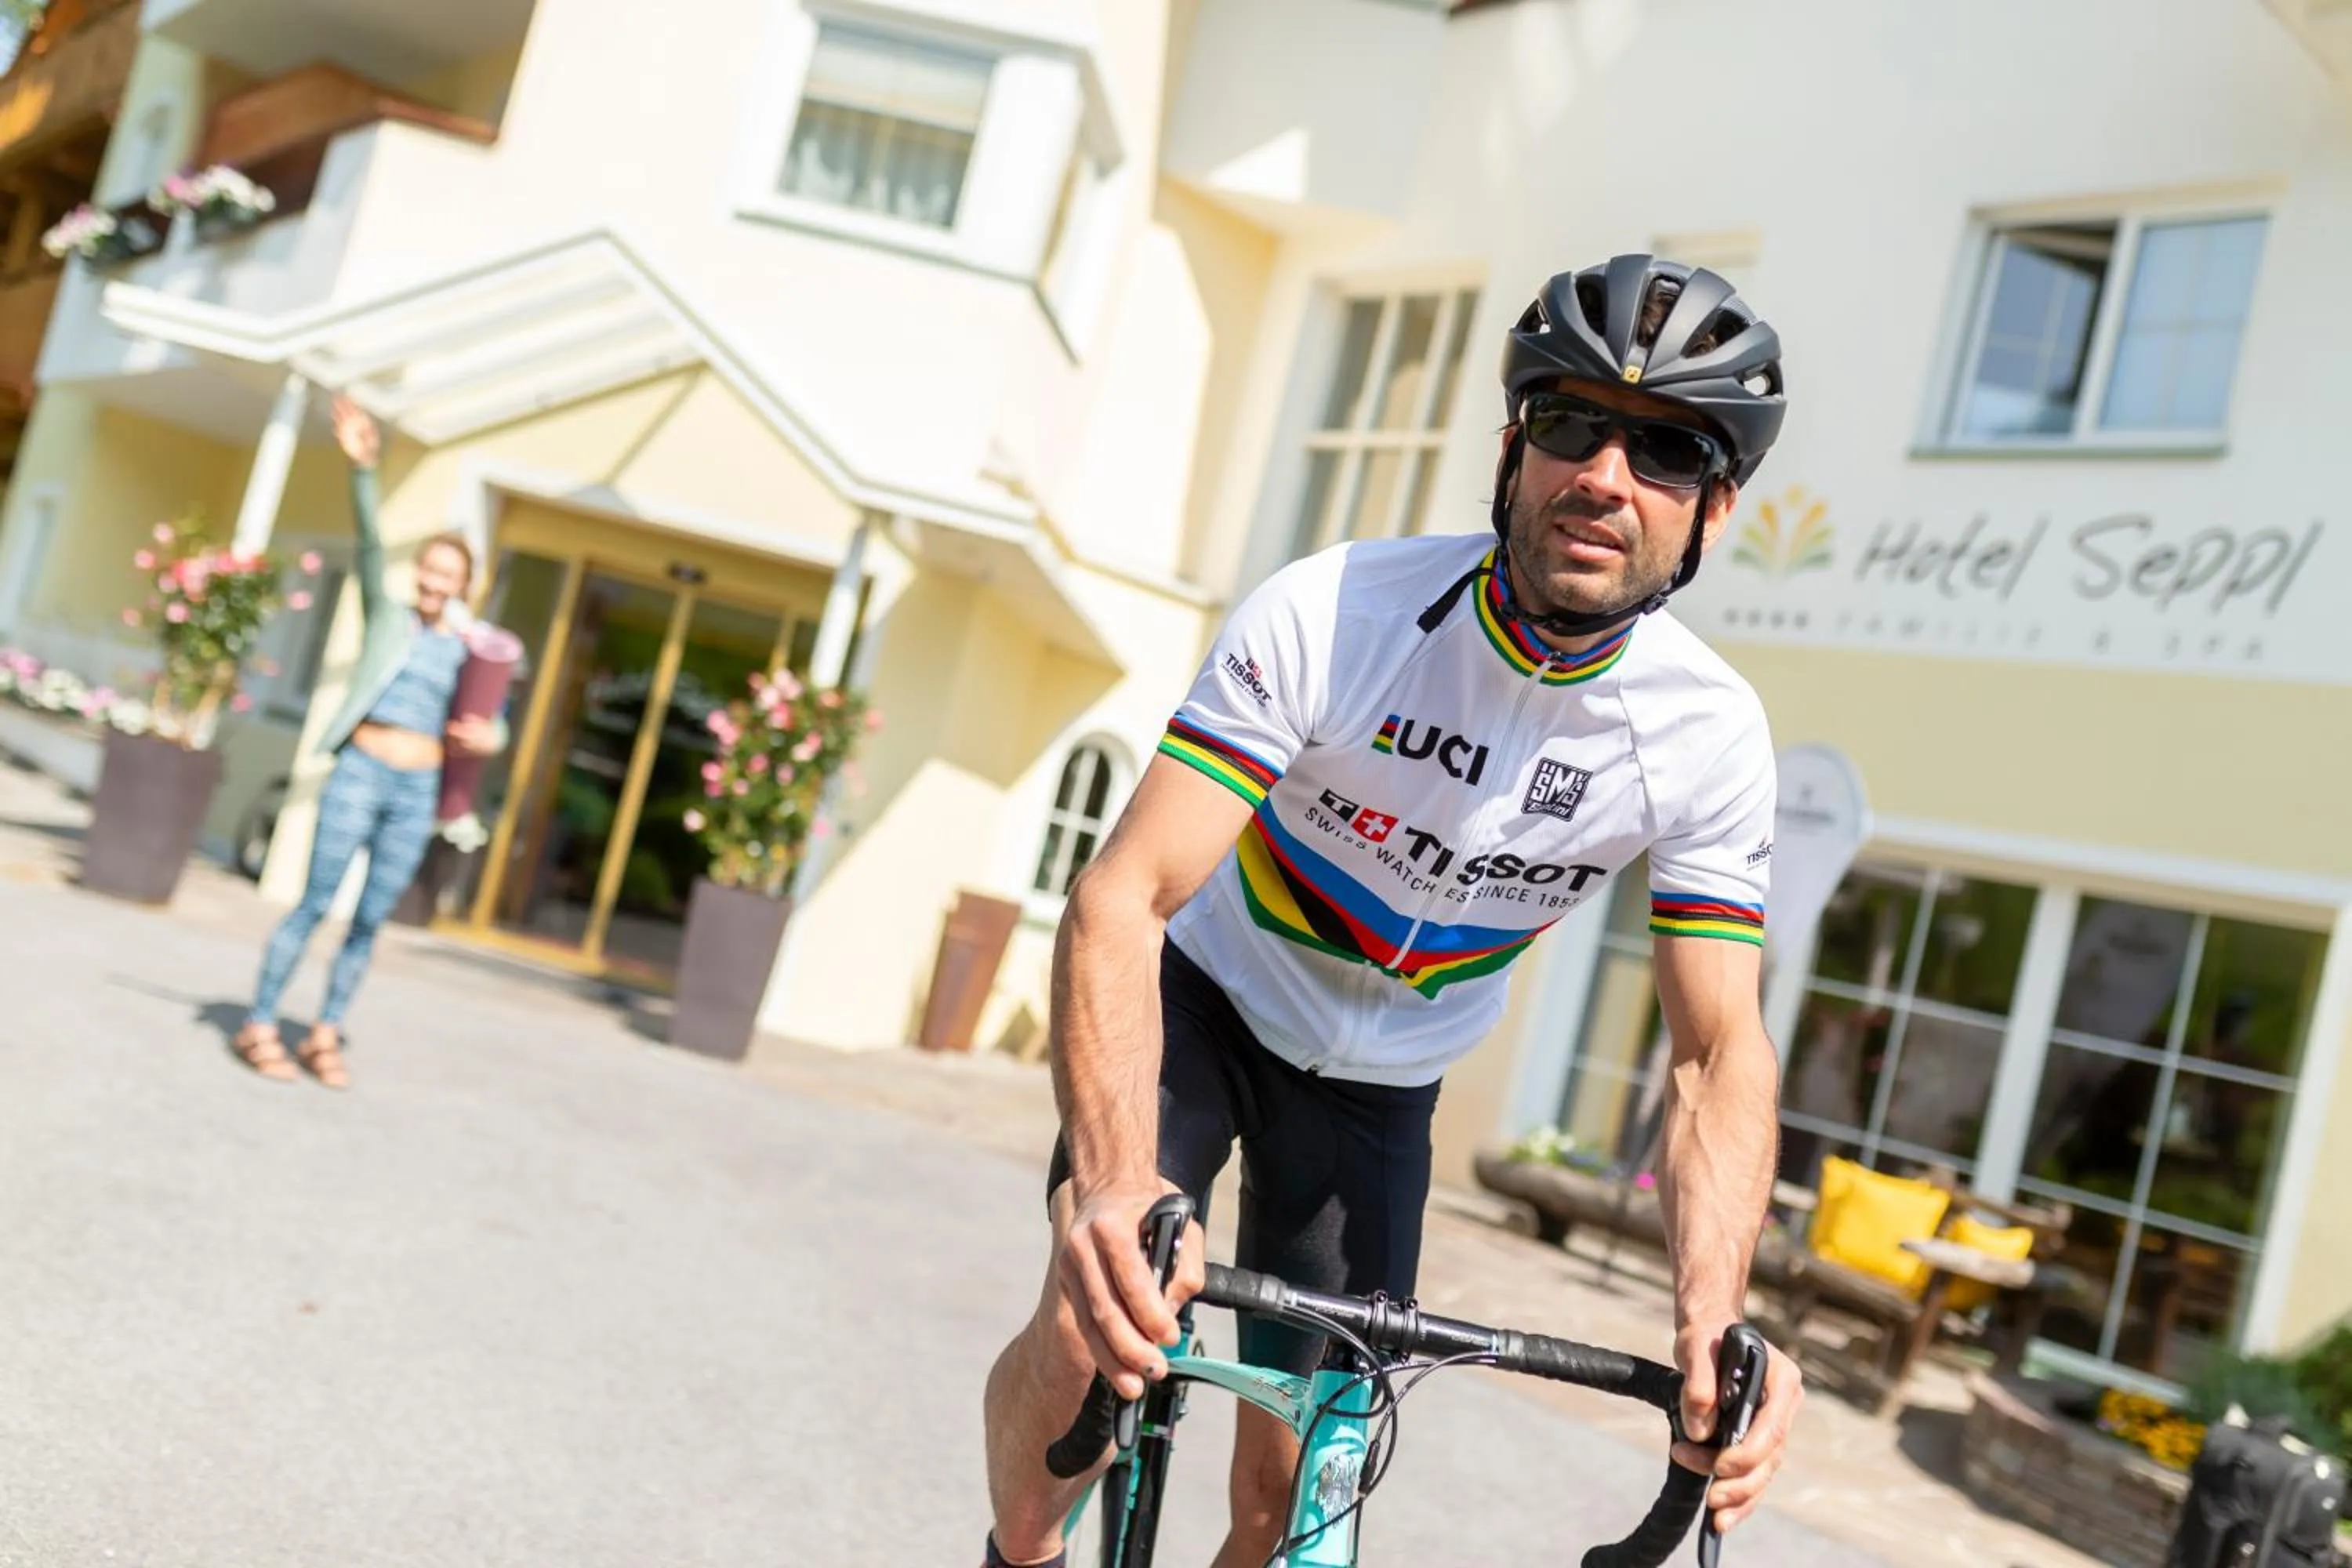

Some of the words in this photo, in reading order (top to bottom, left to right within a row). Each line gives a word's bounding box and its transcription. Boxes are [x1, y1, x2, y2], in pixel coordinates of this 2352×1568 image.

[1853, 514, 2053, 602] Hotel
[2070, 514, 2325, 616] Seppl
[1226, 653, 1272, 701] TISSOT
[1397, 719, 1489, 786] UCI
[1305, 807, 1368, 850] SWISS
[1472, 884, 1531, 902] SINCE
[1405, 826, 1608, 892] TISSOT
